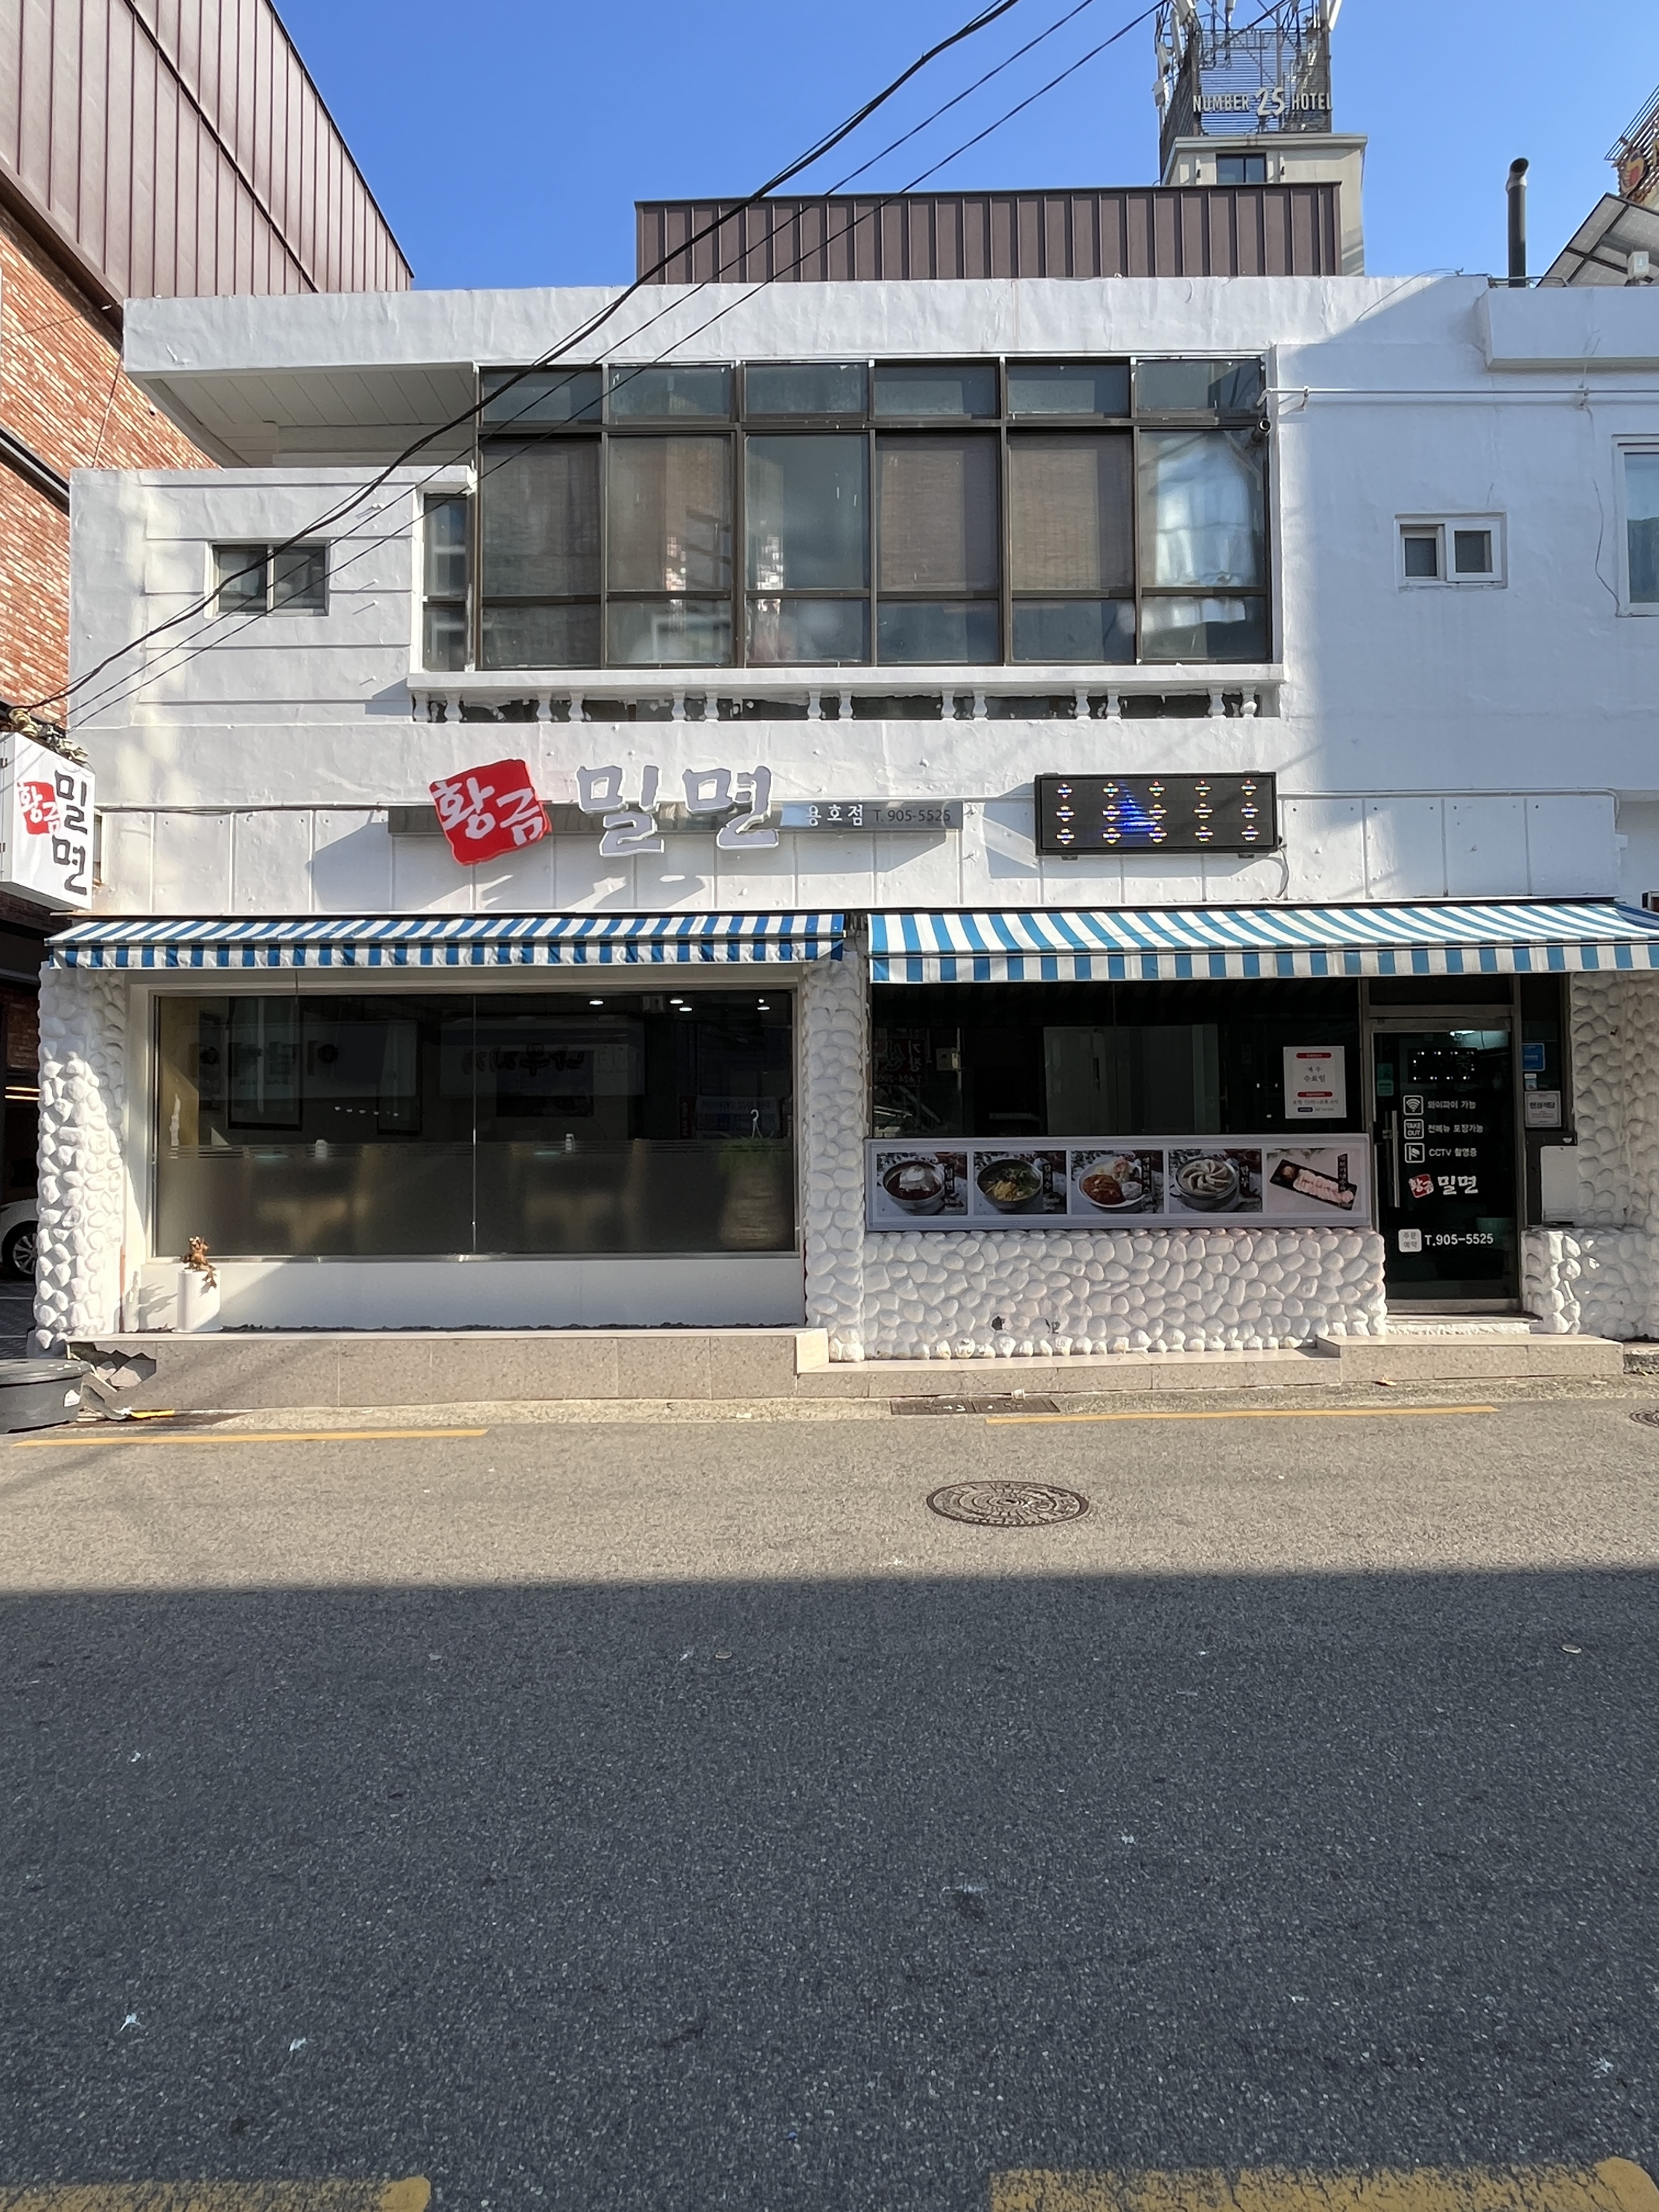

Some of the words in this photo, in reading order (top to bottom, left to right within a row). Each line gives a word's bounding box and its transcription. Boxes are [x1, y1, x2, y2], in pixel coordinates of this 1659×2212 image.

[1193, 94, 1249, 112] NUMBER
[1255, 86, 1285, 116] 25
[1291, 92, 1333, 111] HOTEL
[18, 785, 61, 833] 황금
[431, 777, 544, 847] 황금
[575, 765, 779, 857] 밀면
[806, 804, 864, 827] 용호점
[52, 769, 88, 896] 밀면
[1427, 1100, 1459, 1109] 와이파이
[1461, 1100, 1476, 1109] 가능
[1427, 1124, 1451, 1133] 전메뉴
[1429, 1148, 1452, 1157] CCTV
[1437, 1175, 1479, 1195] 밀면
[1424, 1233, 1494, 1247] T.905-5525
